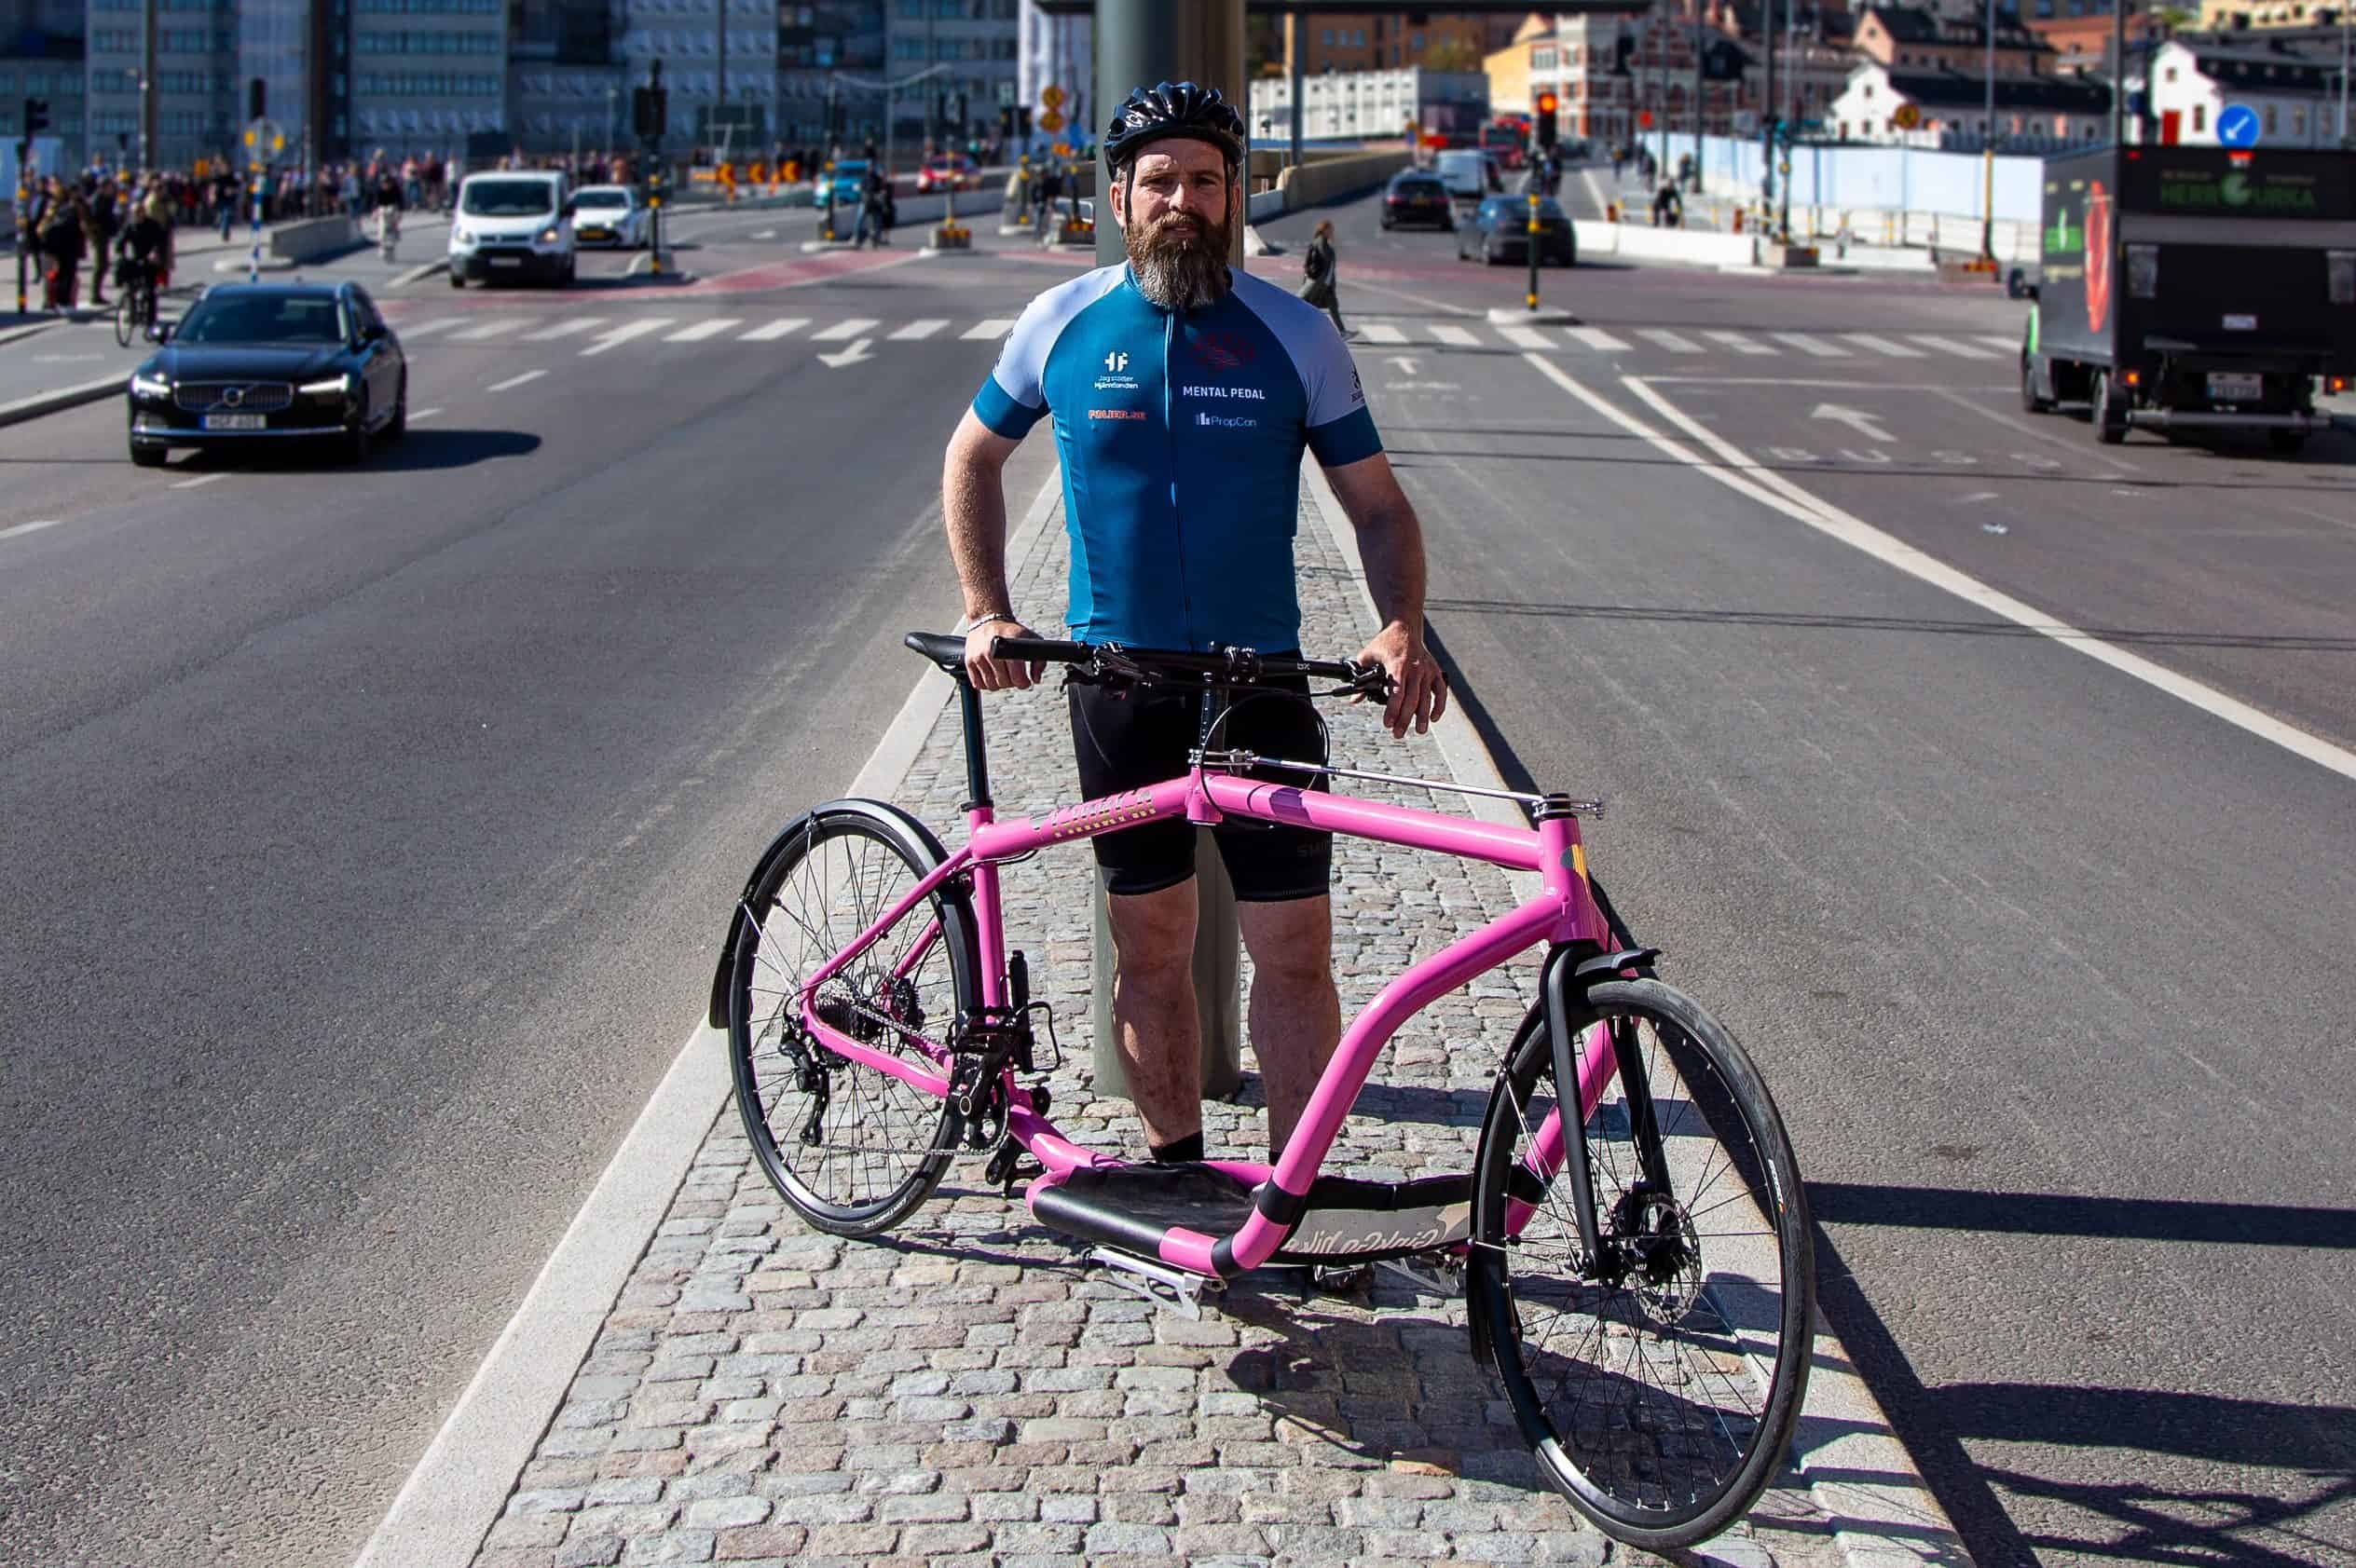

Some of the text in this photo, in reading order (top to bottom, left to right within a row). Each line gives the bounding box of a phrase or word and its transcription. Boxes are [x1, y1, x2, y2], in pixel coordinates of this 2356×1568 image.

[1183, 385, 1267, 400] MENTAL PEDAL
[1211, 416, 1257, 429] PropCon
